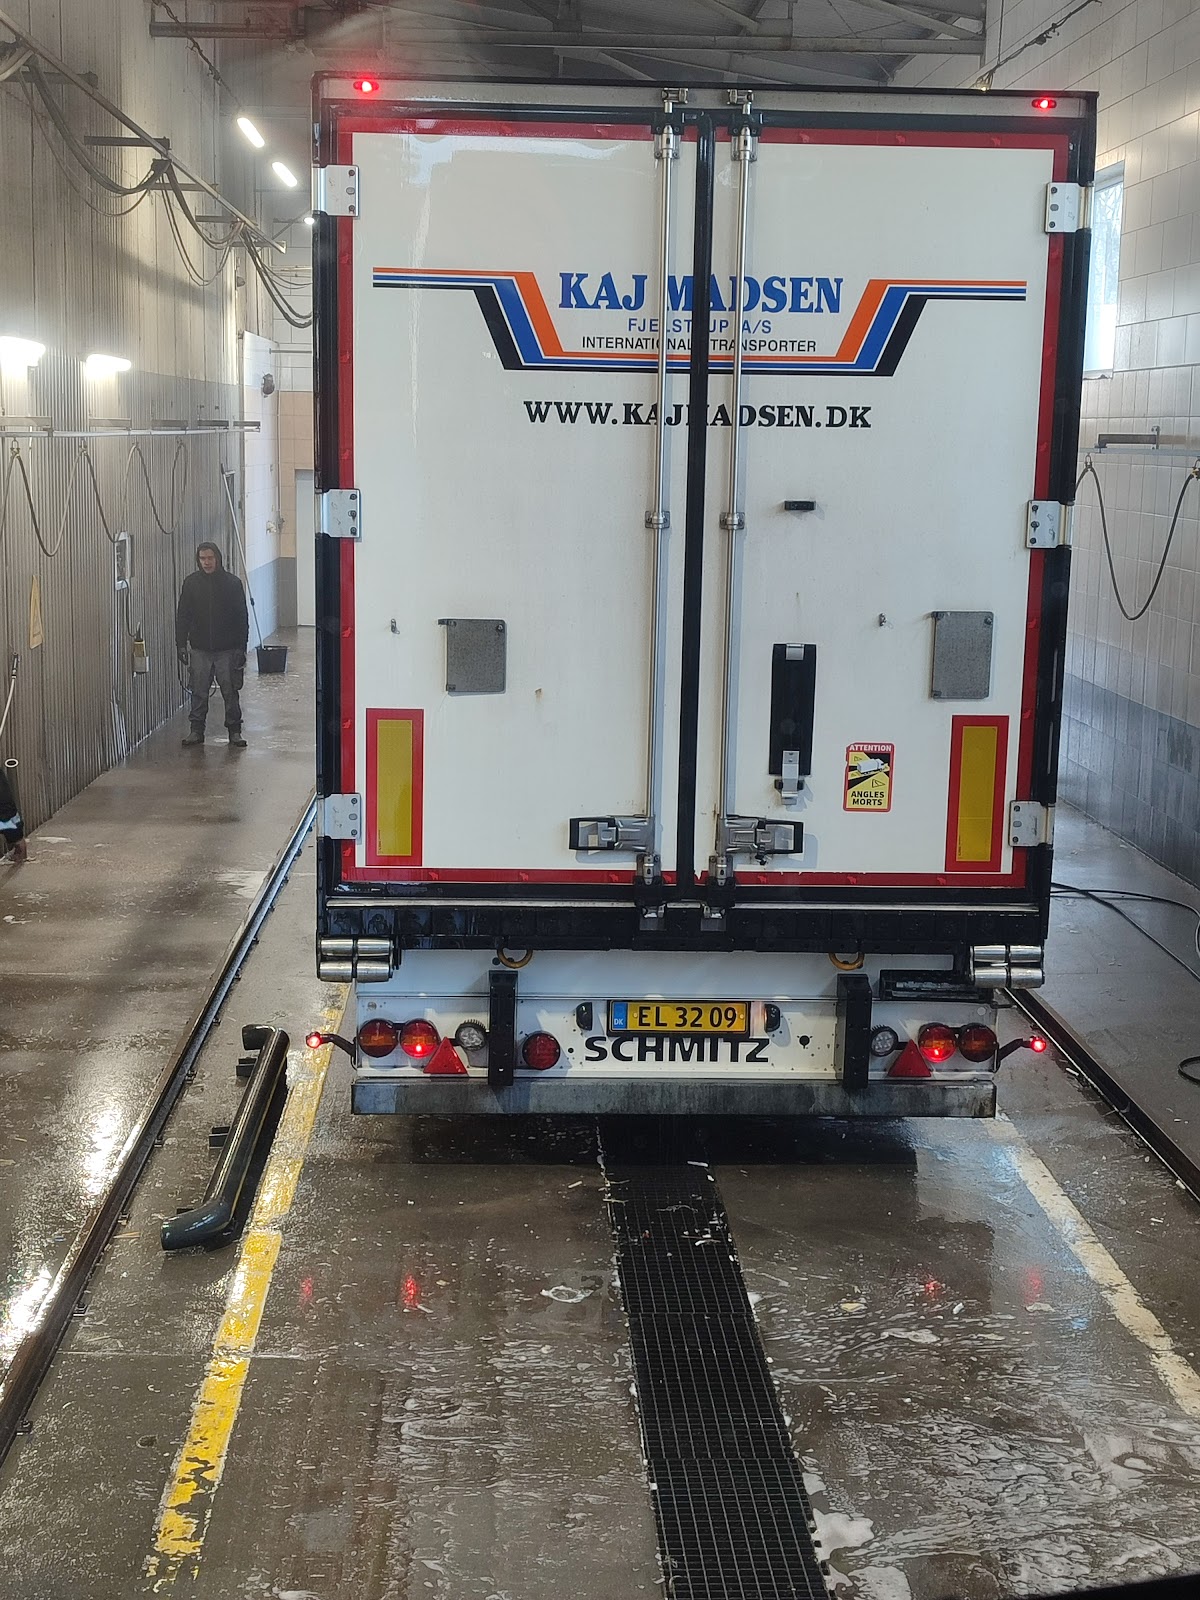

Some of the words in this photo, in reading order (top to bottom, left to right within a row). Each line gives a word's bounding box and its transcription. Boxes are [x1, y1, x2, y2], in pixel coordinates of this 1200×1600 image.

[558, 271, 648, 311] KAJ
[665, 273, 844, 314] MADSEN
[628, 318, 729, 335] FJESTUP
[741, 319, 772, 334] A/S
[582, 336, 692, 351] INTERNATINAL
[710, 338, 817, 353] TRANSPORTER
[524, 401, 872, 429] WWW.KAJADSEN.DK
[849, 744, 892, 752] ATTENTION
[851, 791, 885, 799] ANGLES
[613, 1018, 624, 1026] DK
[638, 1006, 668, 1027] EL
[675, 1006, 703, 1028] 32
[709, 1006, 737, 1028] 09
[584, 1035, 770, 1063] SCHMITZ
